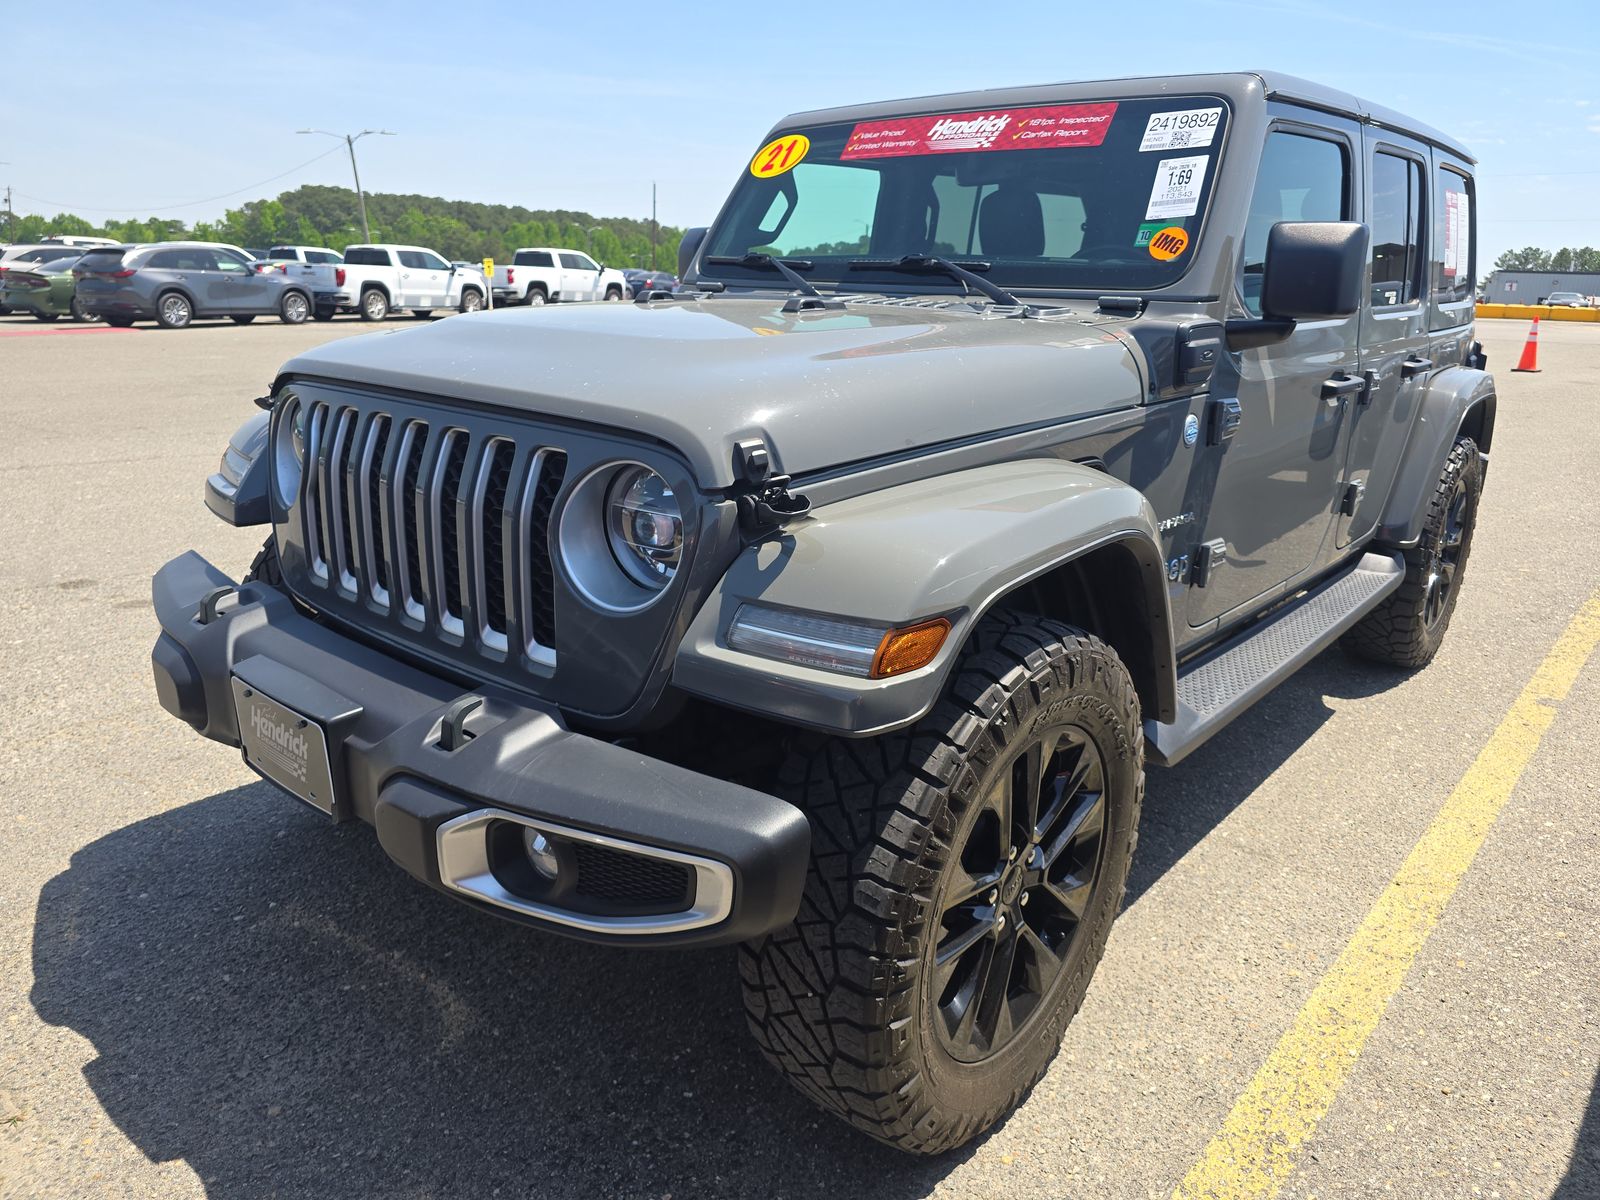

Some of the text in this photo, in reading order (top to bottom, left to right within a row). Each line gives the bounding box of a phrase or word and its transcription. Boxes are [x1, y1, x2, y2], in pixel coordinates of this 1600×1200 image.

[926, 114, 1012, 141] Hendrick
[1058, 114, 1110, 125] Inspected
[1149, 112, 1220, 132] 2419892
[880, 129, 907, 138] Priced
[936, 131, 1001, 140] AFFORDABLE
[1021, 129, 1089, 139] Carfax Report
[854, 139, 921, 151] Limited Warranty
[760, 139, 798, 173] 21
[1168, 169, 1193, 186] 1:69
[1152, 232, 1185, 255] IMG
[251, 704, 309, 760] Hendrick
